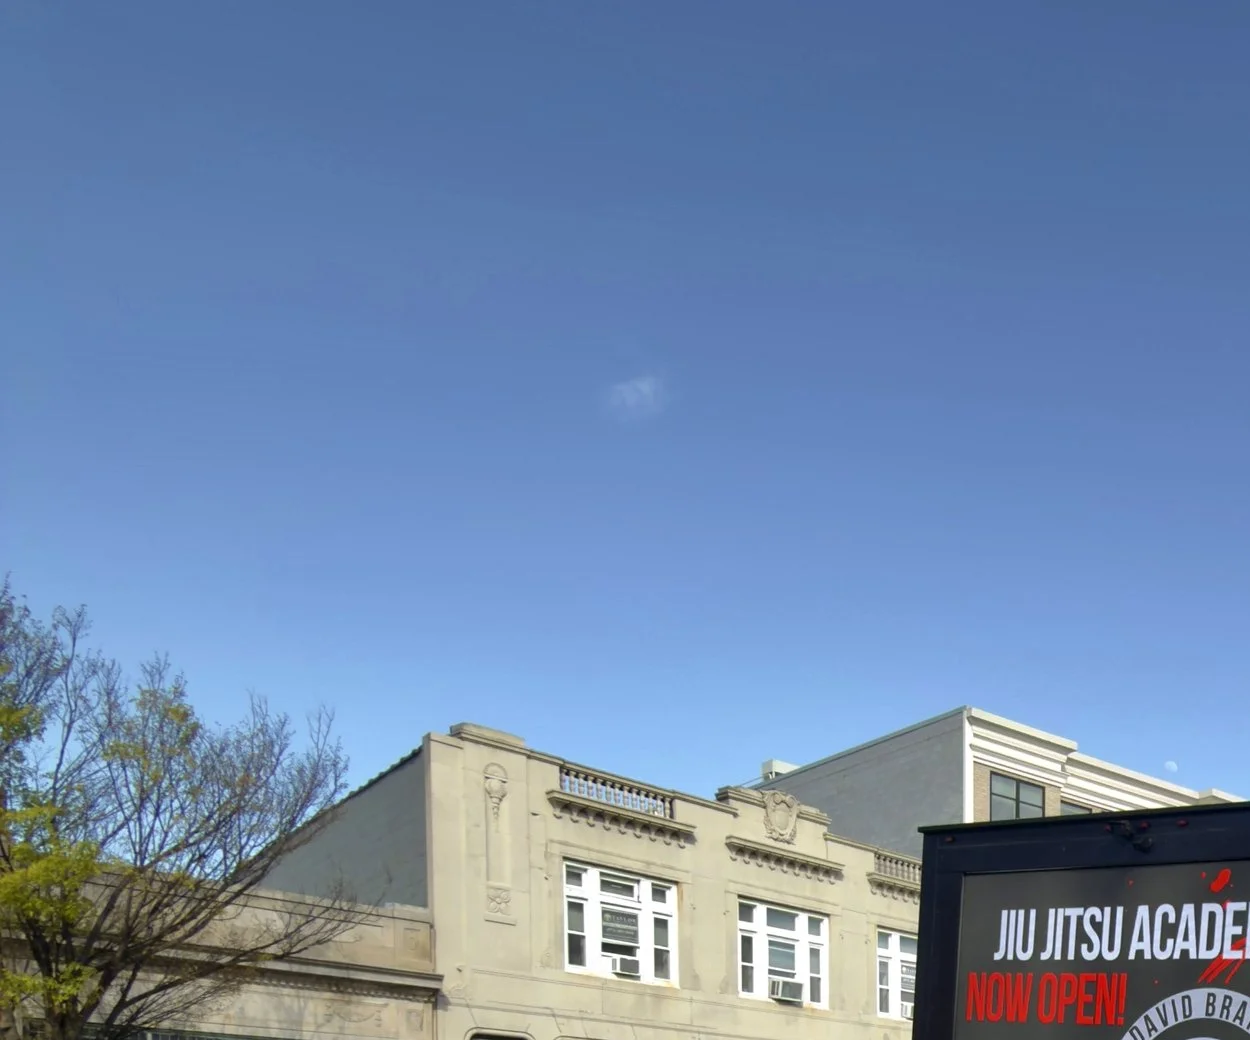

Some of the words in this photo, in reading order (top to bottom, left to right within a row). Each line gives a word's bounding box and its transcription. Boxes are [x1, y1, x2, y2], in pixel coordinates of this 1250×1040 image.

[993, 908, 1037, 961] JIU
[1040, 905, 1124, 961] JITSU
[966, 972, 1036, 1023] NOW
[1037, 972, 1128, 1026] OPEN!
